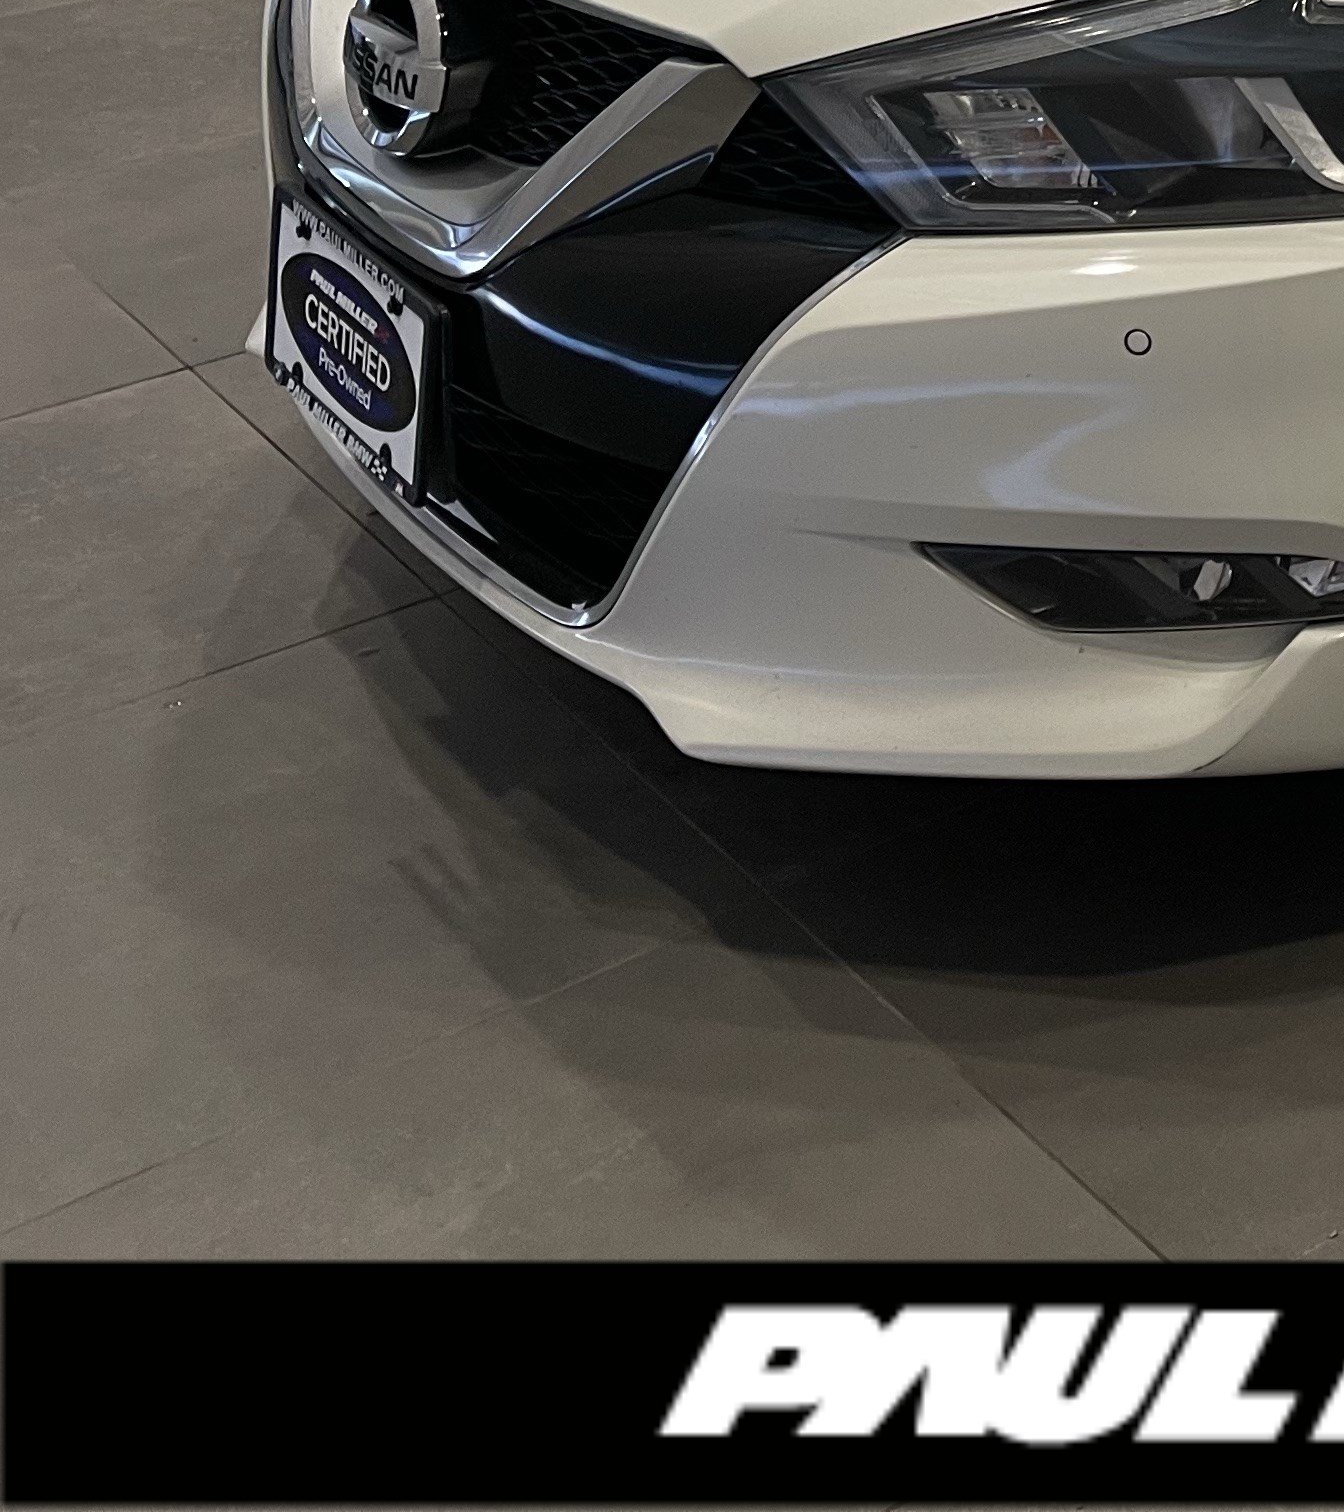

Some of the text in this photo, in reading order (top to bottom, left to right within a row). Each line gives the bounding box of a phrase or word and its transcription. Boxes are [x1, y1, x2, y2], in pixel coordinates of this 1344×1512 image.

[309, 268, 379, 336] PAUL MILLER
[304, 293, 391, 392] CERTIFIED
[318, 345, 372, 411] Pre-Owned
